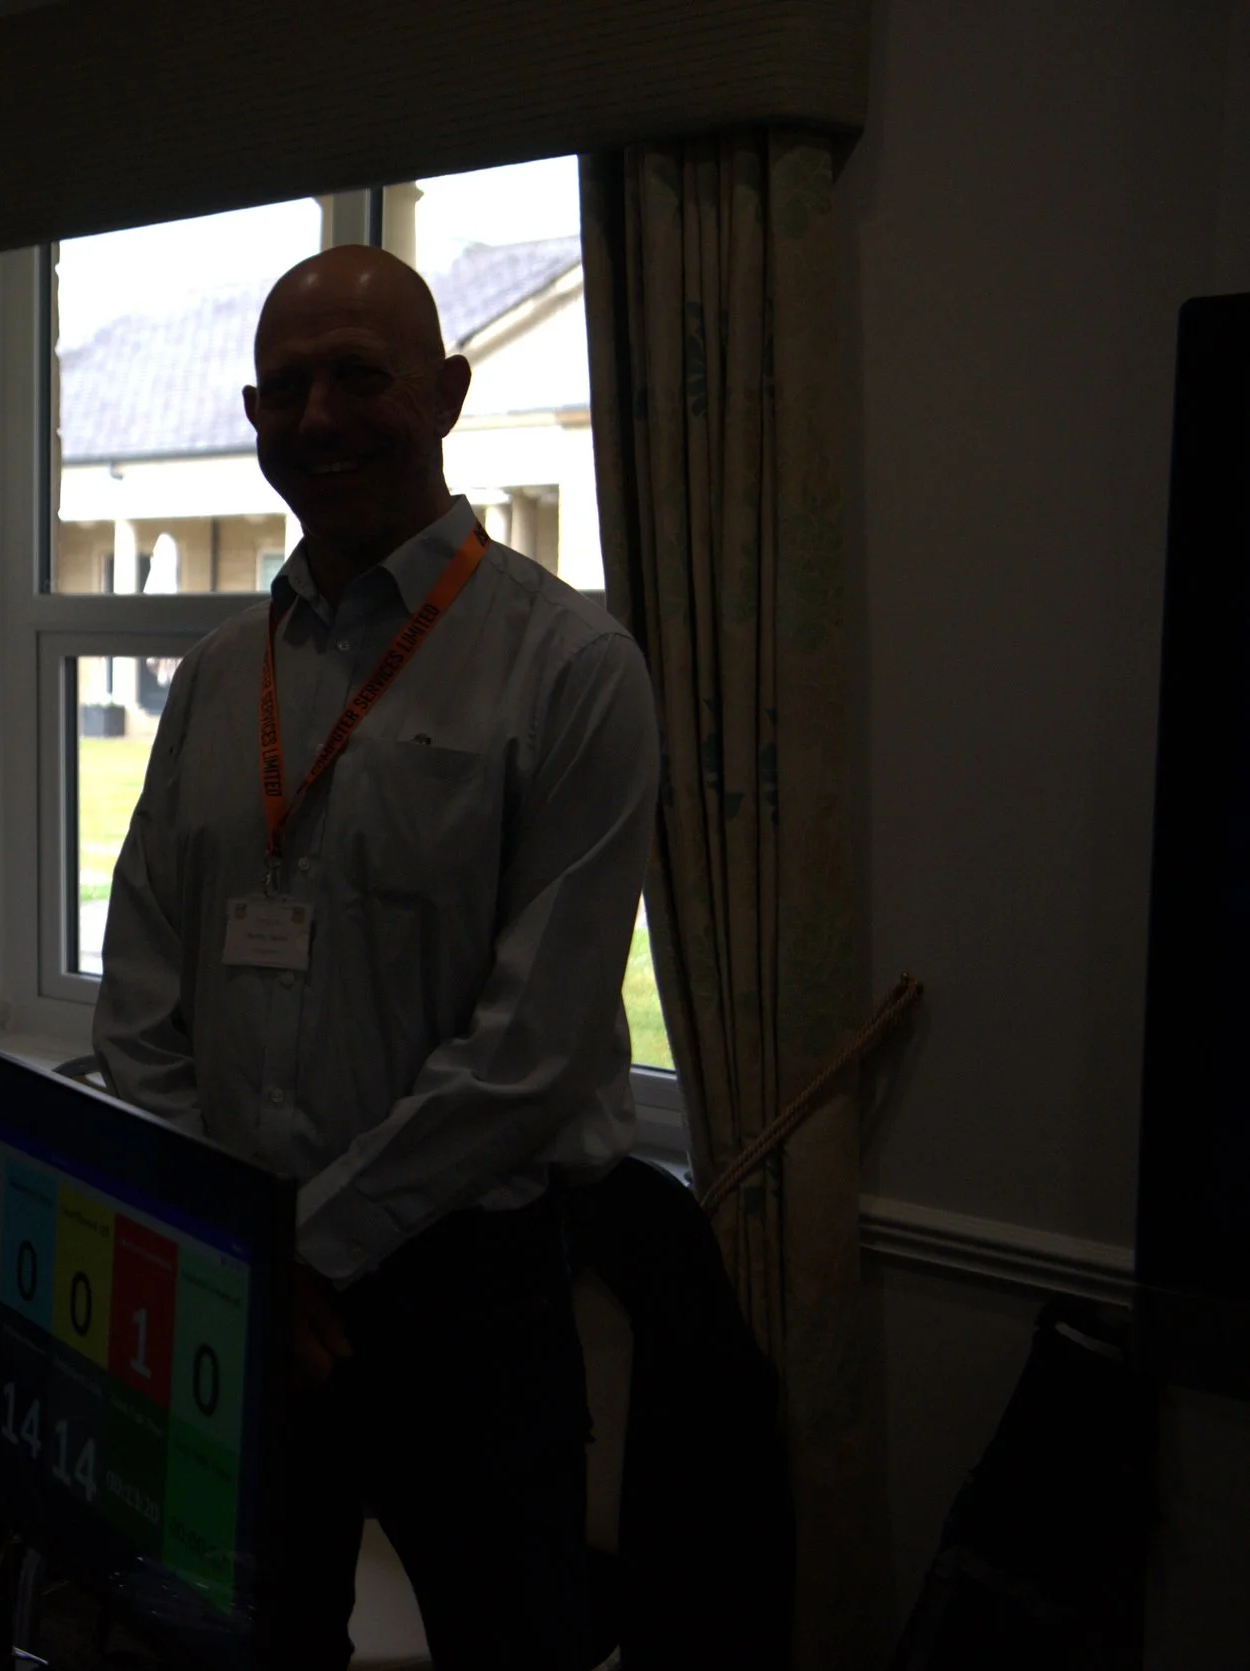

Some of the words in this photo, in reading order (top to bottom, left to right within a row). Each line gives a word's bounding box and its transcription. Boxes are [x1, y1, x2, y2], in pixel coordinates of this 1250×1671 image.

[311, 709, 359, 777] COMPUTER
[353, 649, 405, 710] SERVICES
[400, 602, 440, 653] LIMITED
[262, 748, 282, 797] LIMITED
[17, 1240, 37, 1301] 0
[70, 1271, 92, 1337] 0
[130, 1307, 151, 1380] 1
[193, 1343, 219, 1418] 0
[1, 1381, 42, 1460] 14
[52, 1419, 97, 1502] 14
